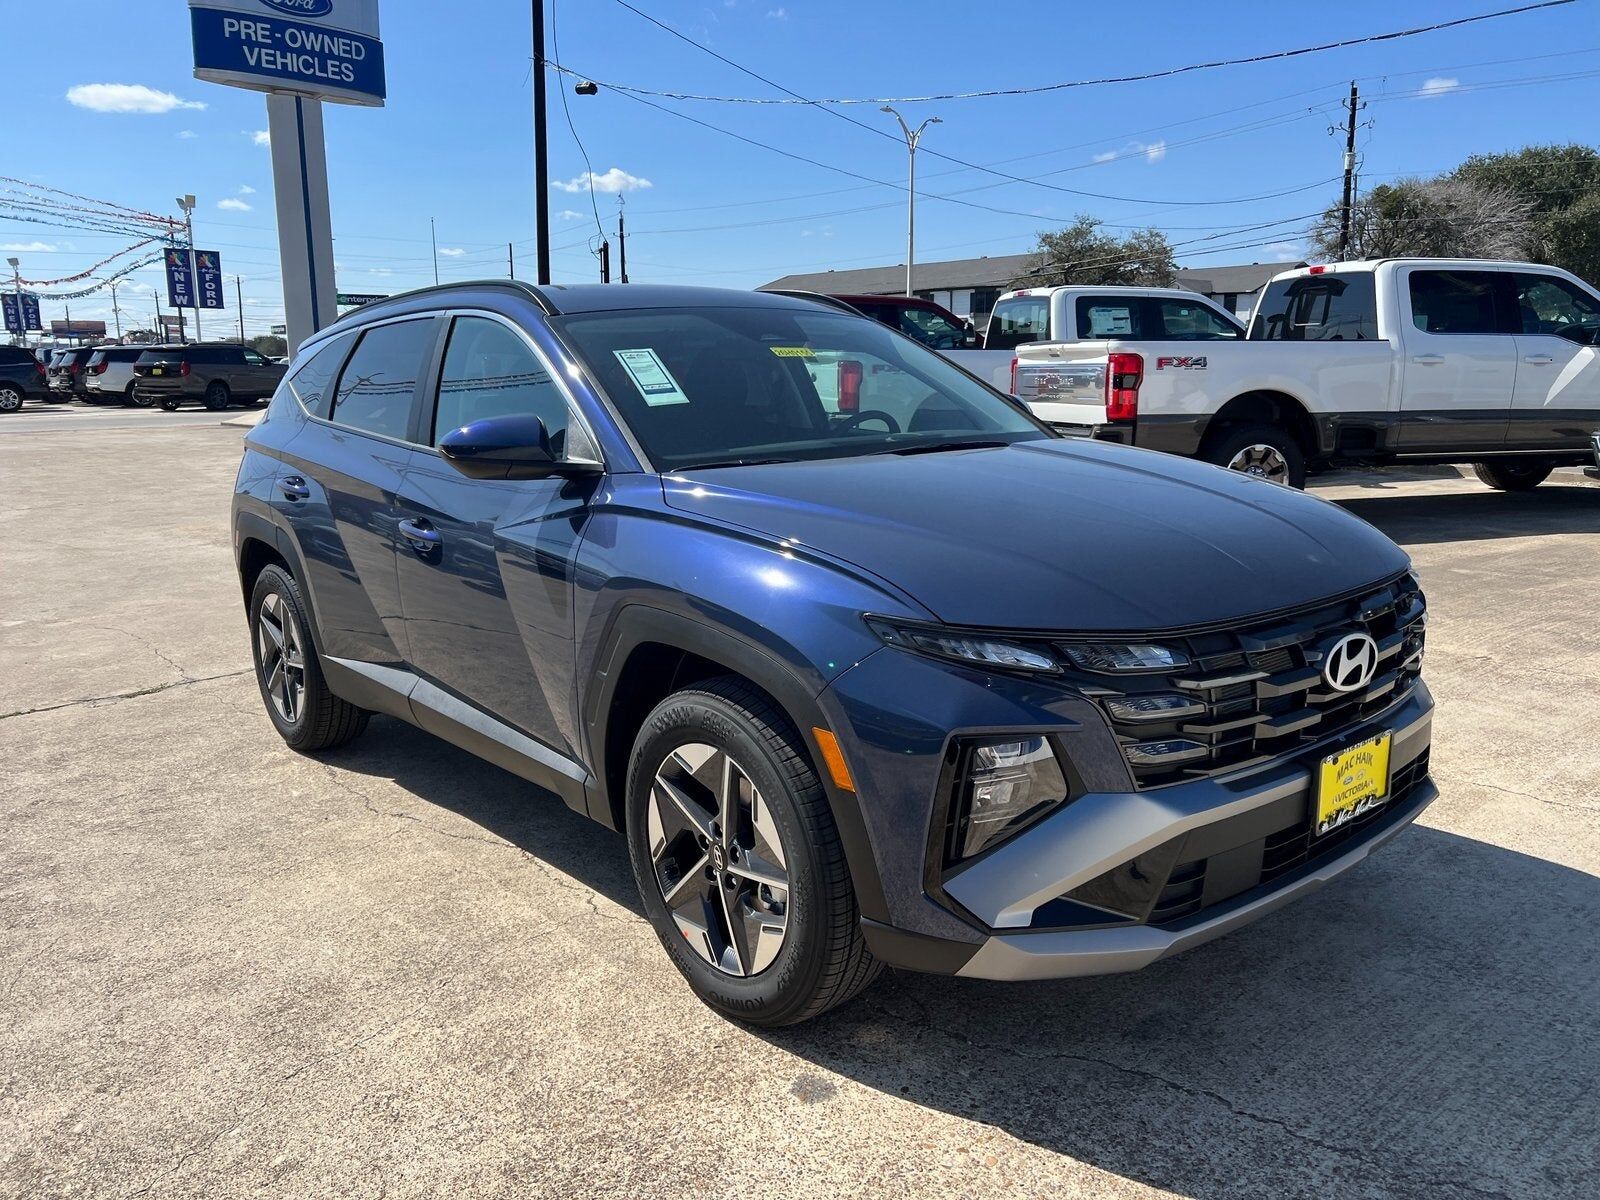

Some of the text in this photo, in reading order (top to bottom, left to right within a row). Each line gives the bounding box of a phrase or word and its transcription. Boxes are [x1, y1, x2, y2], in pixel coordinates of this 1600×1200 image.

[243, 45, 355, 82] VEHICLES
[174, 271, 188, 305] NEW
[205, 273, 217, 307] FORD
[7, 308, 18, 329] NEW
[28, 308, 37, 329] FORD
[1156, 356, 1208, 370] FX4
[1336, 755, 1355, 783] MAC
[1355, 752, 1374, 767] HAIK
